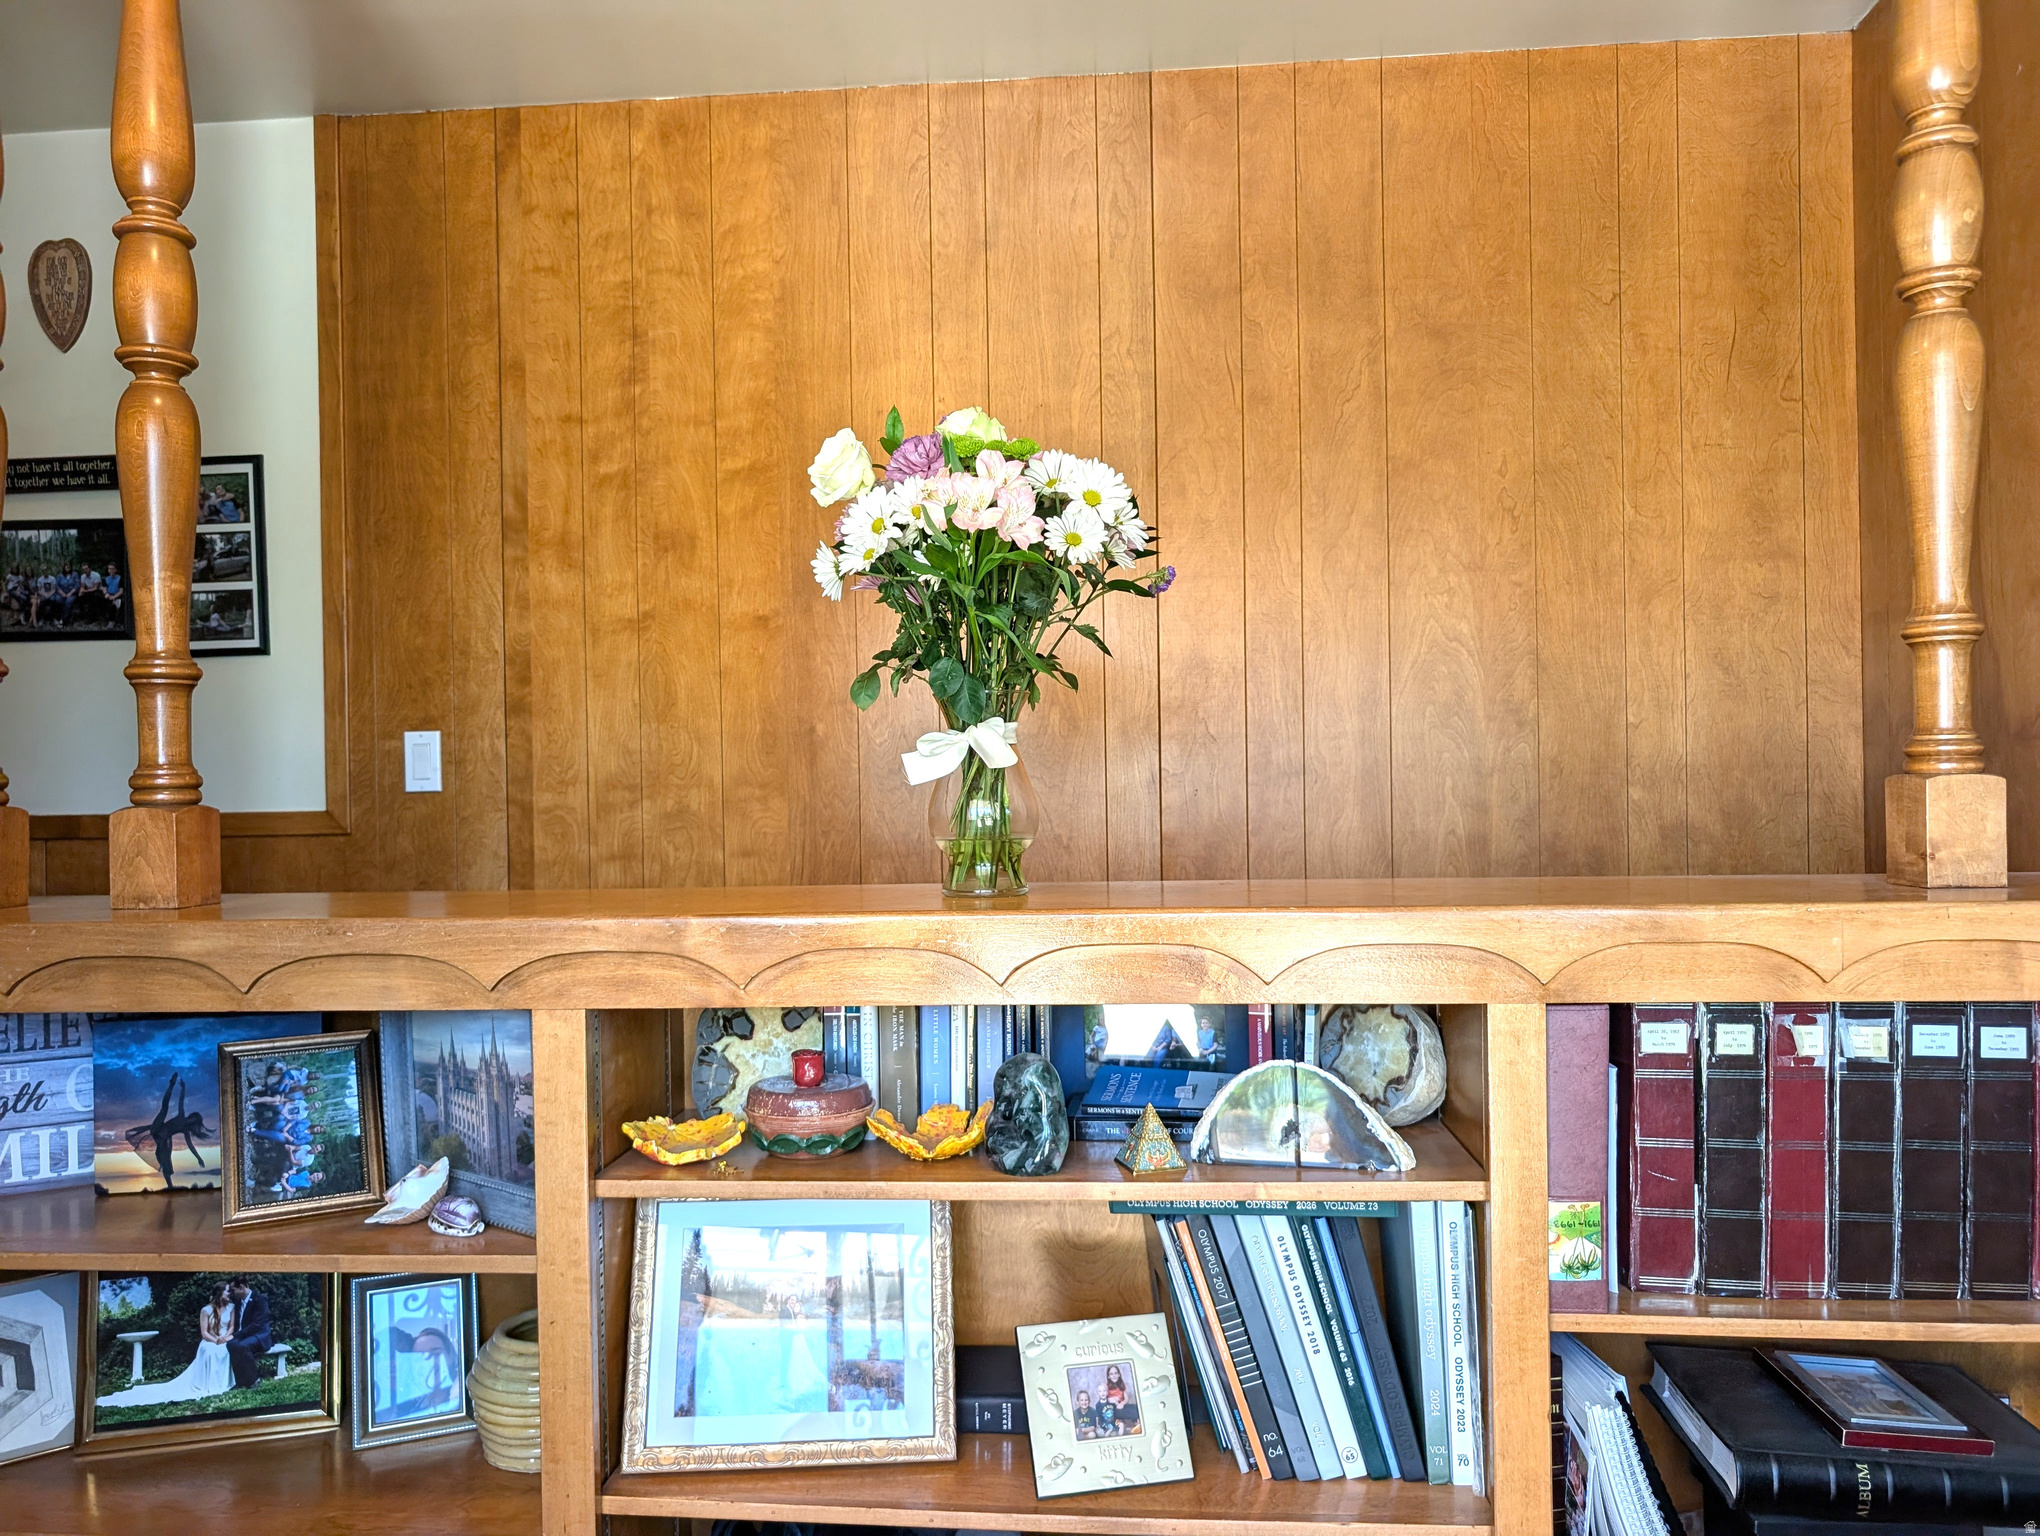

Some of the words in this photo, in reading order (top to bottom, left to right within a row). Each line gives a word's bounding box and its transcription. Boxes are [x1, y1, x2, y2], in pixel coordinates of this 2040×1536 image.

[16, 463, 30, 473] not
[32, 462, 52, 472] have
[54, 462, 60, 472] it
[62, 461, 73, 471] all
[76, 460, 114, 472] together.
[14, 477, 48, 488] together
[52, 478, 65, 486] we
[67, 475, 86, 485] have
[88, 474, 95, 484] it
[98, 474, 110, 484] all.
[864, 1012, 872, 1026] IN
[864, 1032, 874, 1080] CHRIST
[1101, 1073, 1121, 1101] SERMONS
[1120, 1072, 1141, 1103] SENTENCE
[1127, 1200, 1171, 1208] OLYMPUS
[1173, 1200, 1198, 1208] HIGH
[1199, 1200, 1239, 1208] SCHOOL
[1245, 1201, 1289, 1209] ODYSSEY
[1296, 1201, 1316, 1209] 2026
[1323, 1202, 1365, 1210] VOLUME
[1368, 1202, 1378, 1211] 73
[1420, 1222, 1432, 1274] olympus
[1449, 1221, 1459, 1271] OLYMPUS
[1182, 1261, 1193, 1282] OLYMPUS
[1198, 1229, 1219, 1274] OLYMPUS
[1214, 1277, 1228, 1299] 2017
[1252, 1235, 1270, 1274] OLYMPUS
[1265, 1274, 1276, 1297] HIGH
[1278, 1236, 1297, 1281] OLYMPUS
[1293, 1285, 1312, 1327] ODYSSEY
[1307, 1331, 1320, 1355] 2018
[1422, 1278, 1434, 1306] high
[1451, 1274, 1460, 1300] HIGH
[1302, 1224, 1317, 1261] OLYMPUS
[1312, 1261, 1323, 1282] HIGH
[1319, 1282, 1333, 1315] SCHOOL
[1330, 1319, 1344, 1352] VOLUME
[1340, 1352, 1348, 1362] 63
[1344, 1367, 1355, 1386] 2016
[1424, 1311, 1436, 1360] odyssey
[1452, 1303, 1462, 1348] SCHOOL
[1076, 1342, 1124, 1357] curious
[1375, 1348, 1398, 1401] ODYSSEY
[1455, 1357, 1464, 1405] ODYSSEY
[1430, 1390, 1440, 1416] 2024
[1312, 1420, 1322, 1438] VOL
[1389, 1403, 1415, 1460] OLYMPUS
[1457, 1409, 1465, 1432] 2023
[1263, 1433, 1278, 1441] no.
[1291, 1446, 1305, 1454] VOL
[1098, 1445, 1132, 1462] kitty
[1268, 1444, 1284, 1457] 64
[1346, 1452, 1355, 1460] 65
[1434, 1458, 1443, 1466] 71
[1458, 1458, 1469, 1466] 70
[1855, 1462, 1871, 1517] ALBUM
